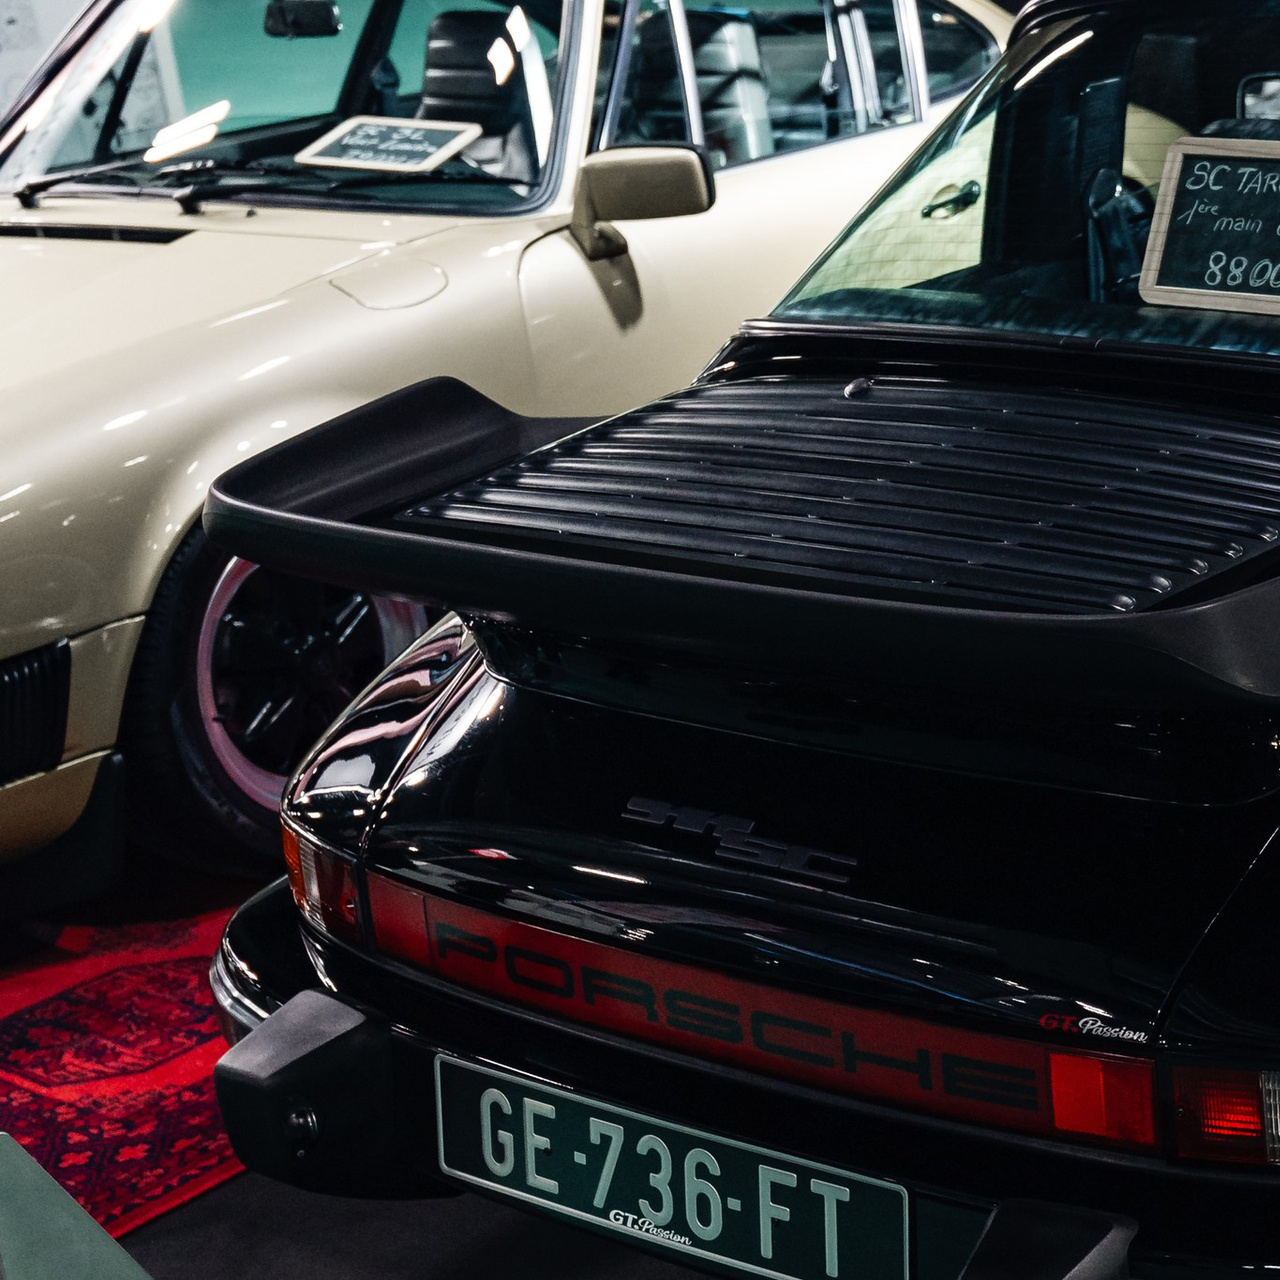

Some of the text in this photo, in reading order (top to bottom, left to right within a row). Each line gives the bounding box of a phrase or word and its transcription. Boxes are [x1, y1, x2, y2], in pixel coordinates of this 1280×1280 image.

[1186, 161, 1230, 190] SC
[1213, 214, 1263, 234] main
[436, 923, 1040, 1112] PORSCHE
[480, 1087, 851, 1278] GE-736-FT
